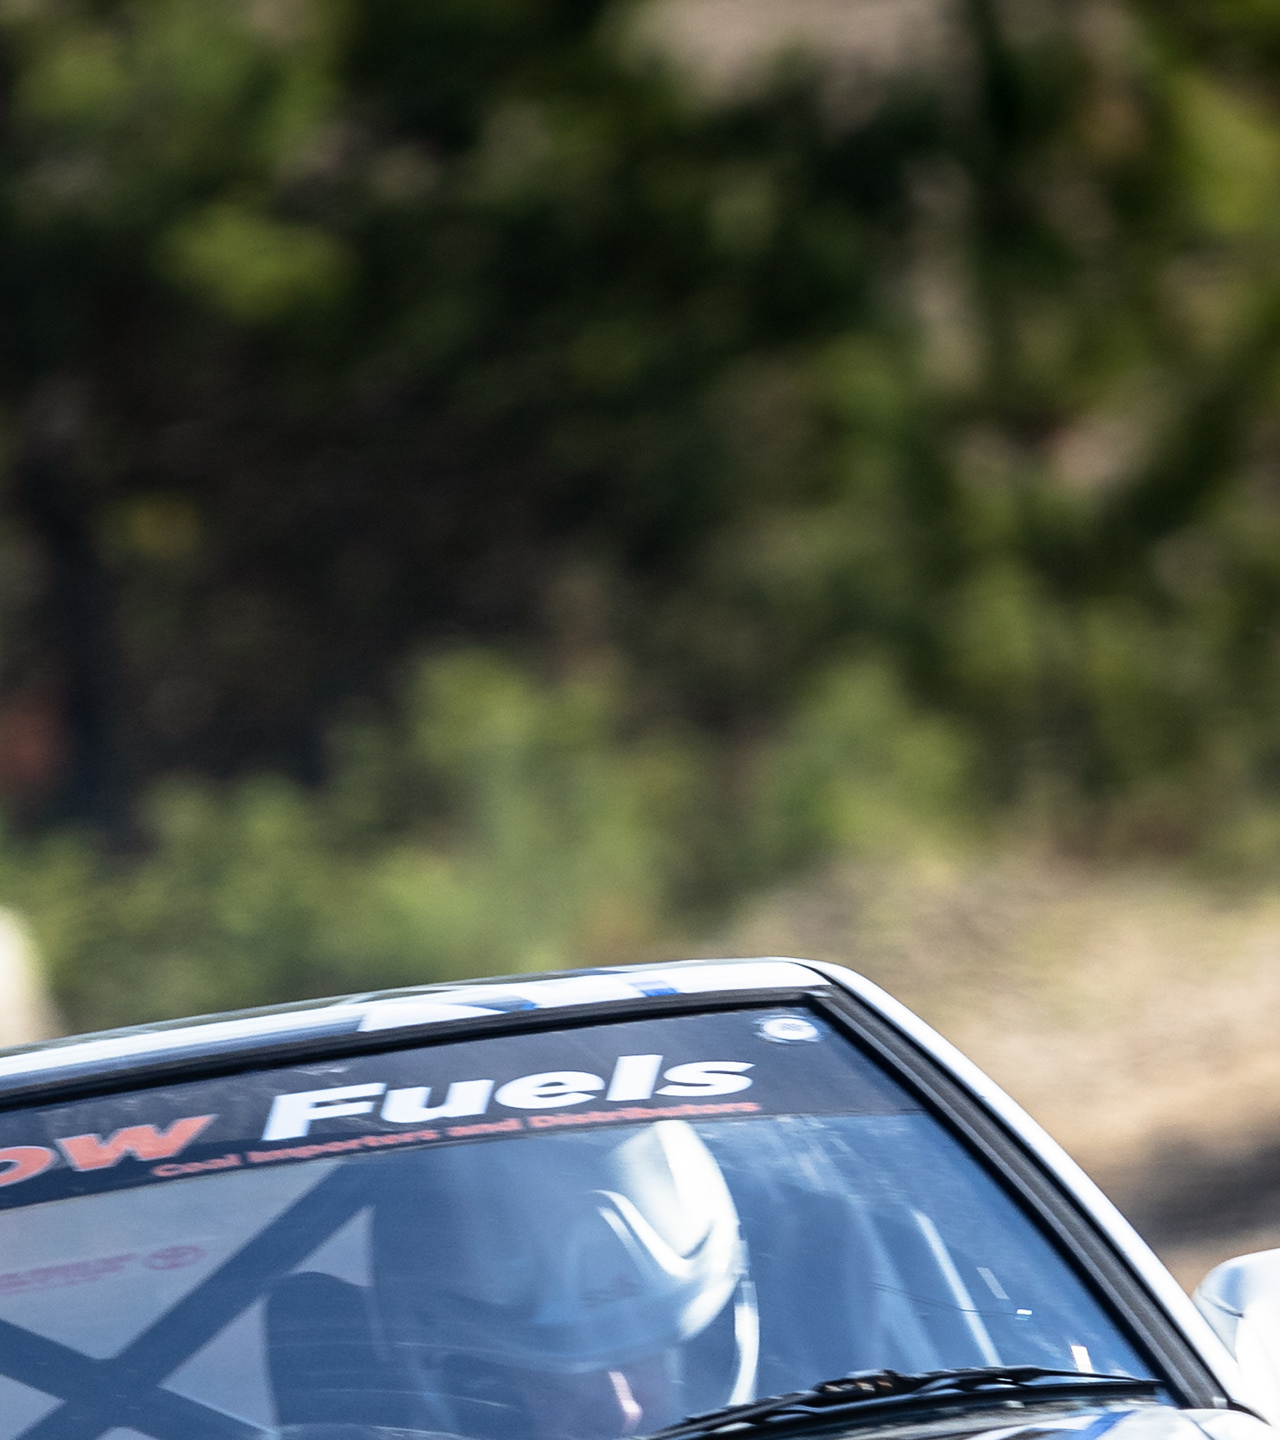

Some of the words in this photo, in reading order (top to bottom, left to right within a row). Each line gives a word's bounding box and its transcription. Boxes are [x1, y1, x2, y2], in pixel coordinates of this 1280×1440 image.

[246, 1129, 440, 1163] Importers
[445, 1117, 522, 1139] and
[526, 1101, 762, 1129] Distributors
[262, 1054, 756, 1142] Fuels
